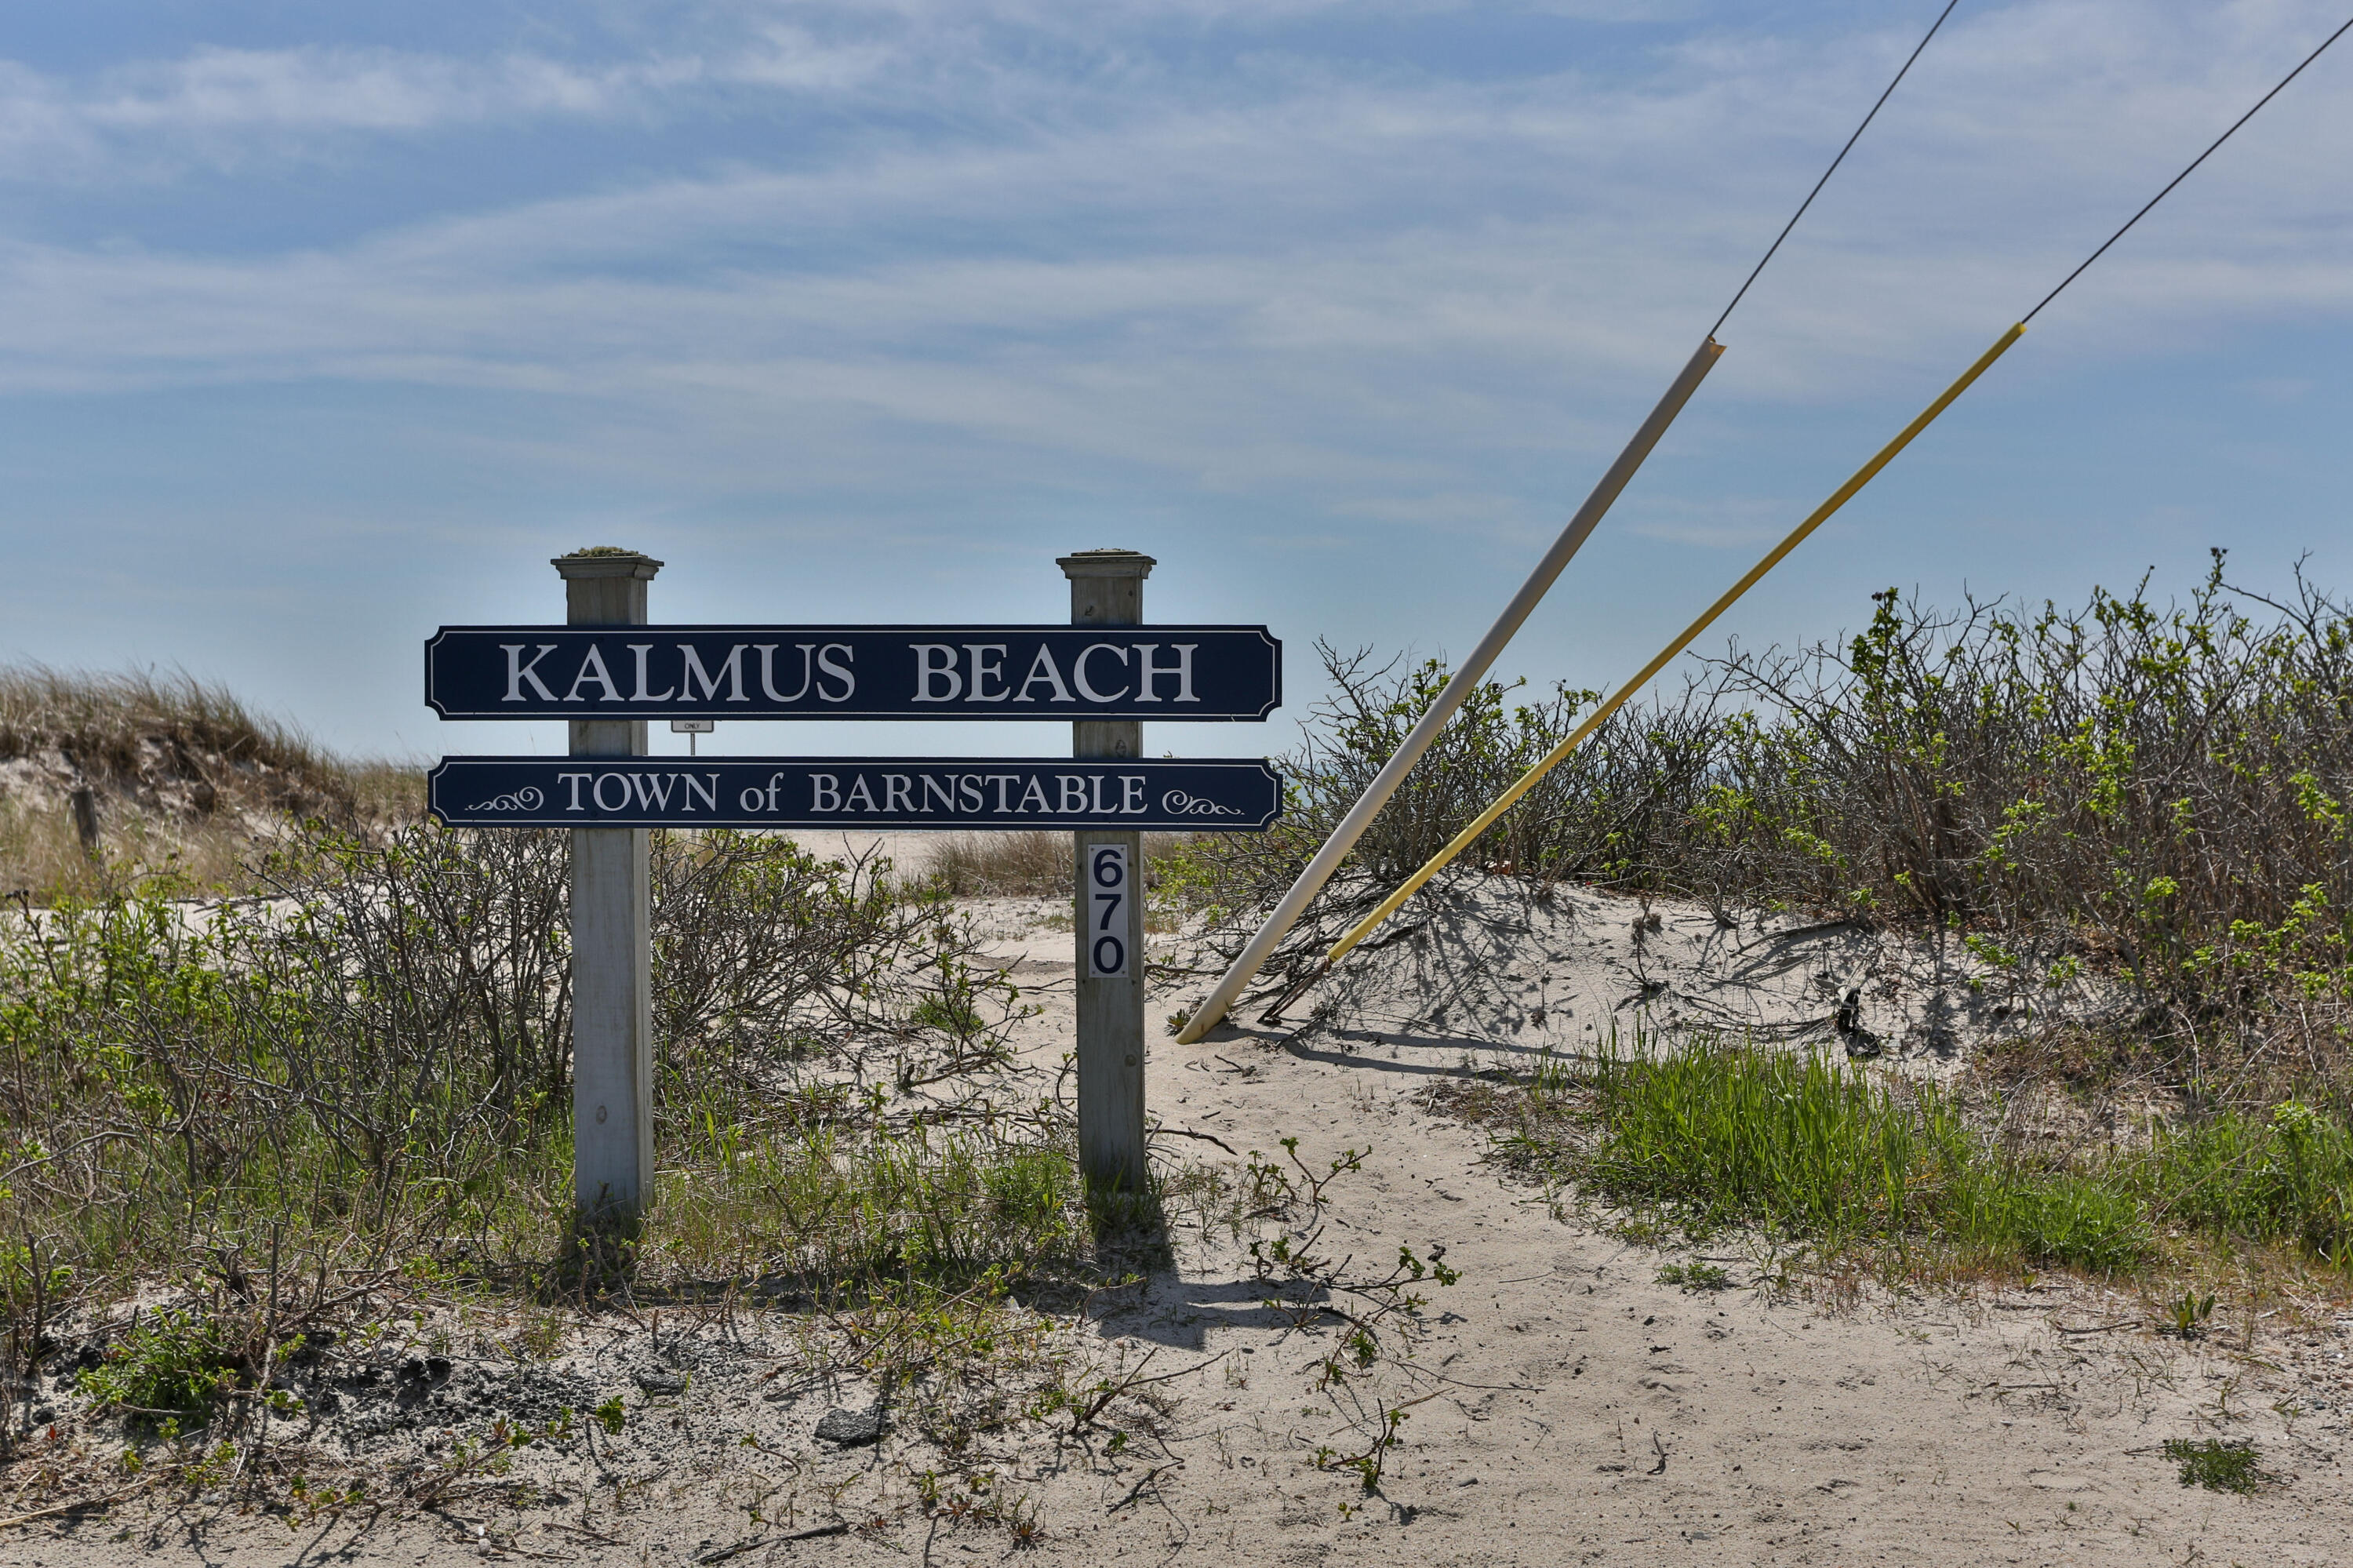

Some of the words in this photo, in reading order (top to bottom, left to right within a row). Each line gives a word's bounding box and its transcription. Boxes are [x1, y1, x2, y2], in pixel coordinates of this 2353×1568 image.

[499, 644, 856, 702] KALMUS
[908, 643, 1202, 703] BEACH
[558, 773, 721, 812] TOWN
[740, 772, 784, 812] of
[809, 773, 1148, 813] BARNSTABLE
[1093, 849, 1124, 973] 670
